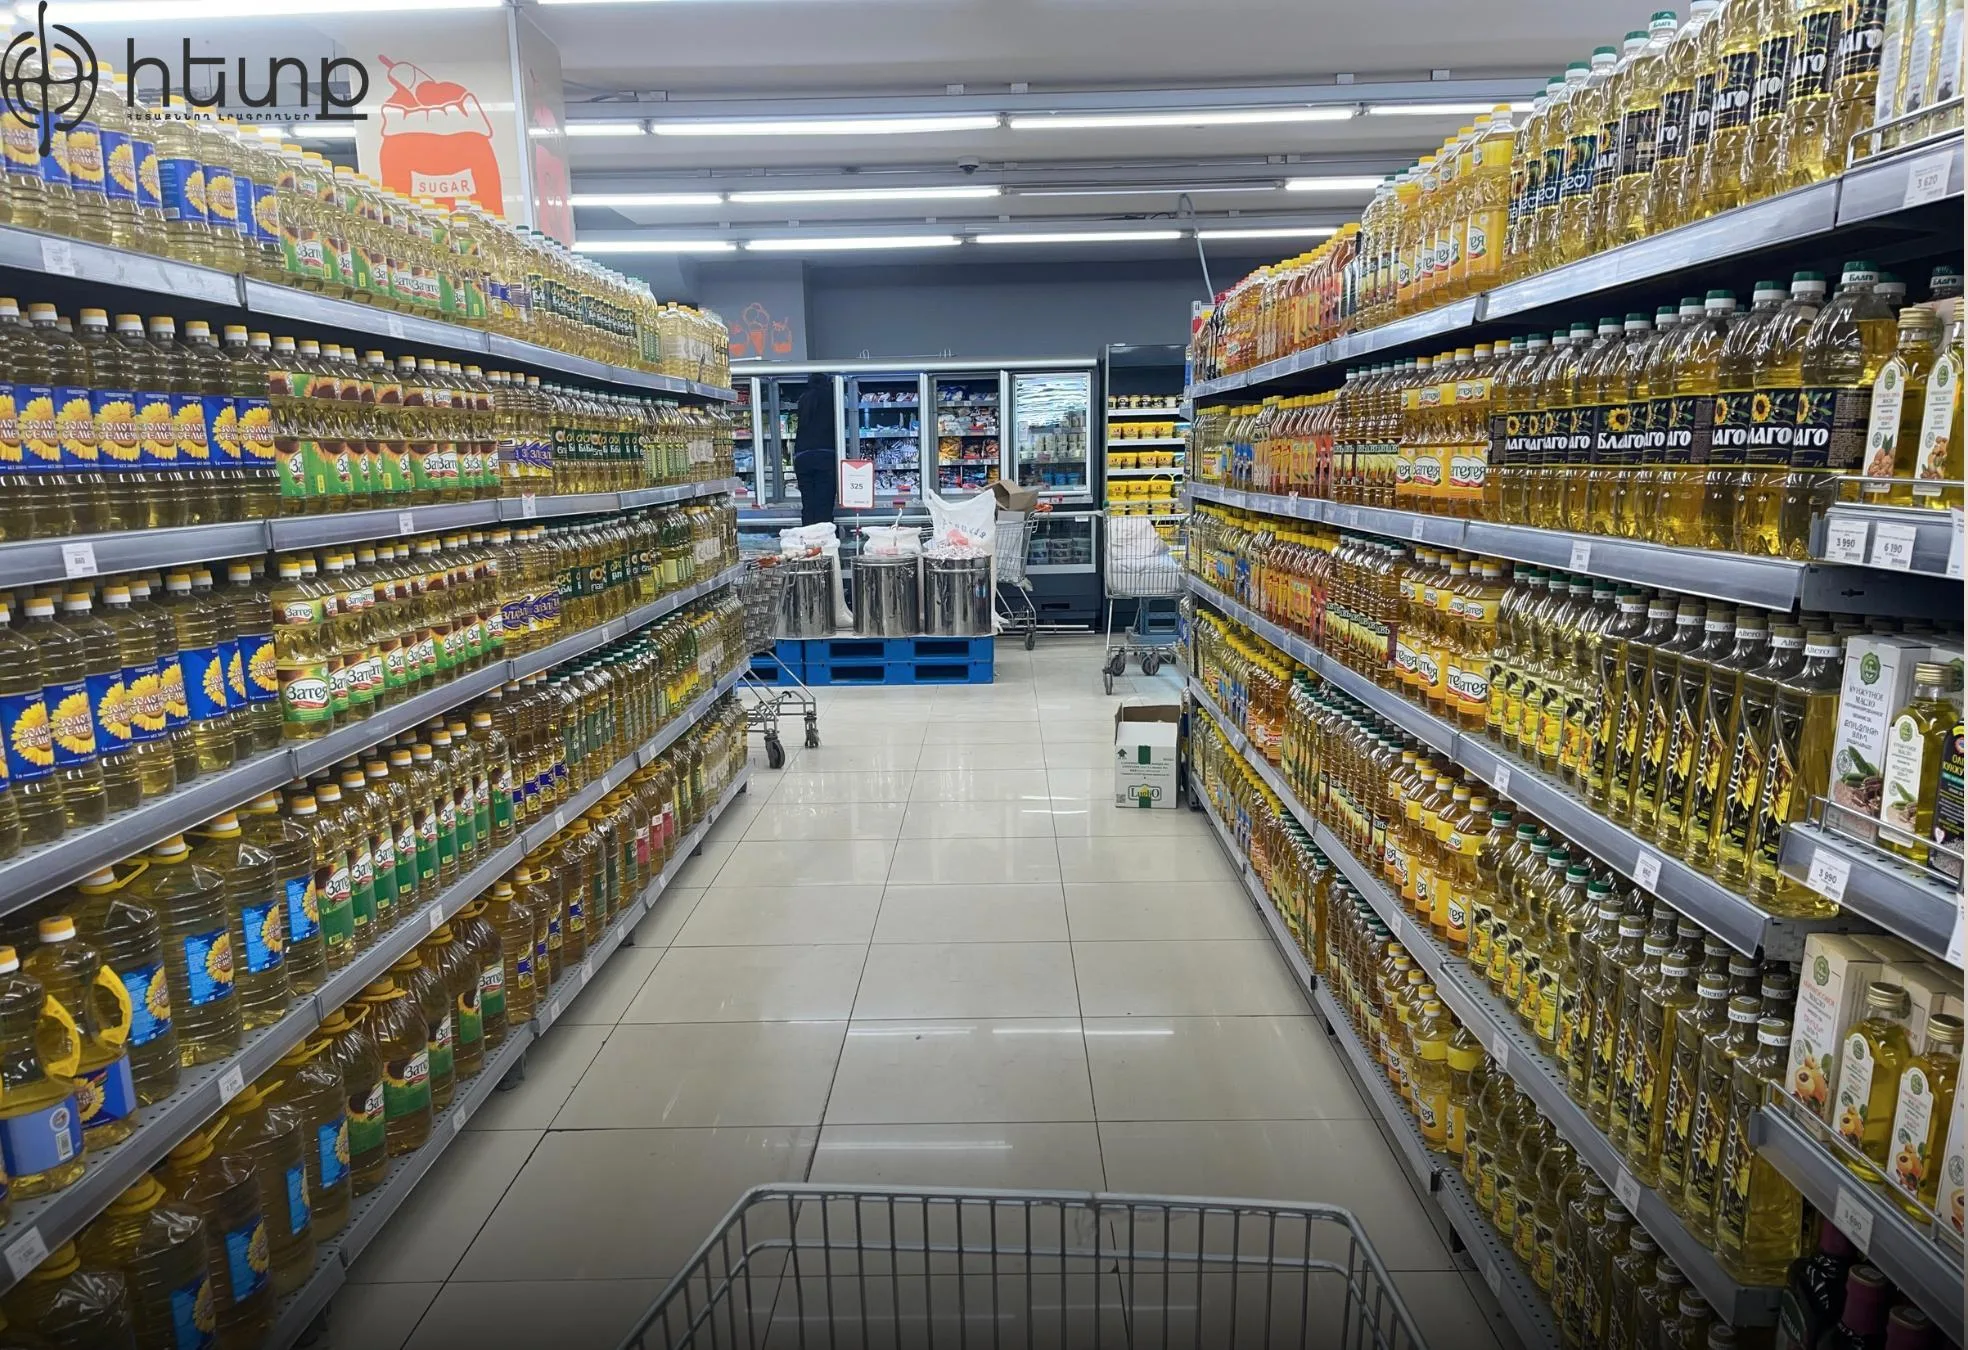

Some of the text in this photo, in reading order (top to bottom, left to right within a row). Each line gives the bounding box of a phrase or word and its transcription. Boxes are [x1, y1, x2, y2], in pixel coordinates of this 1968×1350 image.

[419, 180, 471, 193] SUGAR
[26, 420, 56, 430] ЗОЛОТ
[63, 420, 93, 430] ЗОЛОТ
[101, 422, 136, 432] ЗОЛОТ
[25, 430, 58, 440] СЕМЕ
[62, 430, 95, 440] СЕМЕ
[1667, 429, 1692, 446] АГО
[1712, 428, 1747, 445] АГО
[1793, 428, 1829, 446] АГО
[1569, 435, 1591, 449] АГО
[1842, 538, 1855, 548] 990
[286, 607, 313, 617] Затея
[1738, 630, 1761, 638] Altero
[1460, 680, 1487, 694] атея
[286, 686, 328, 700] Затея
[60, 713, 92, 727] ЗОЛОТ
[57, 725, 90, 737] СЕМЕ
[1824, 872, 1837, 884] 990
[1662, 967, 1684, 975] Altero
[1700, 989, 1723, 997] Altero
